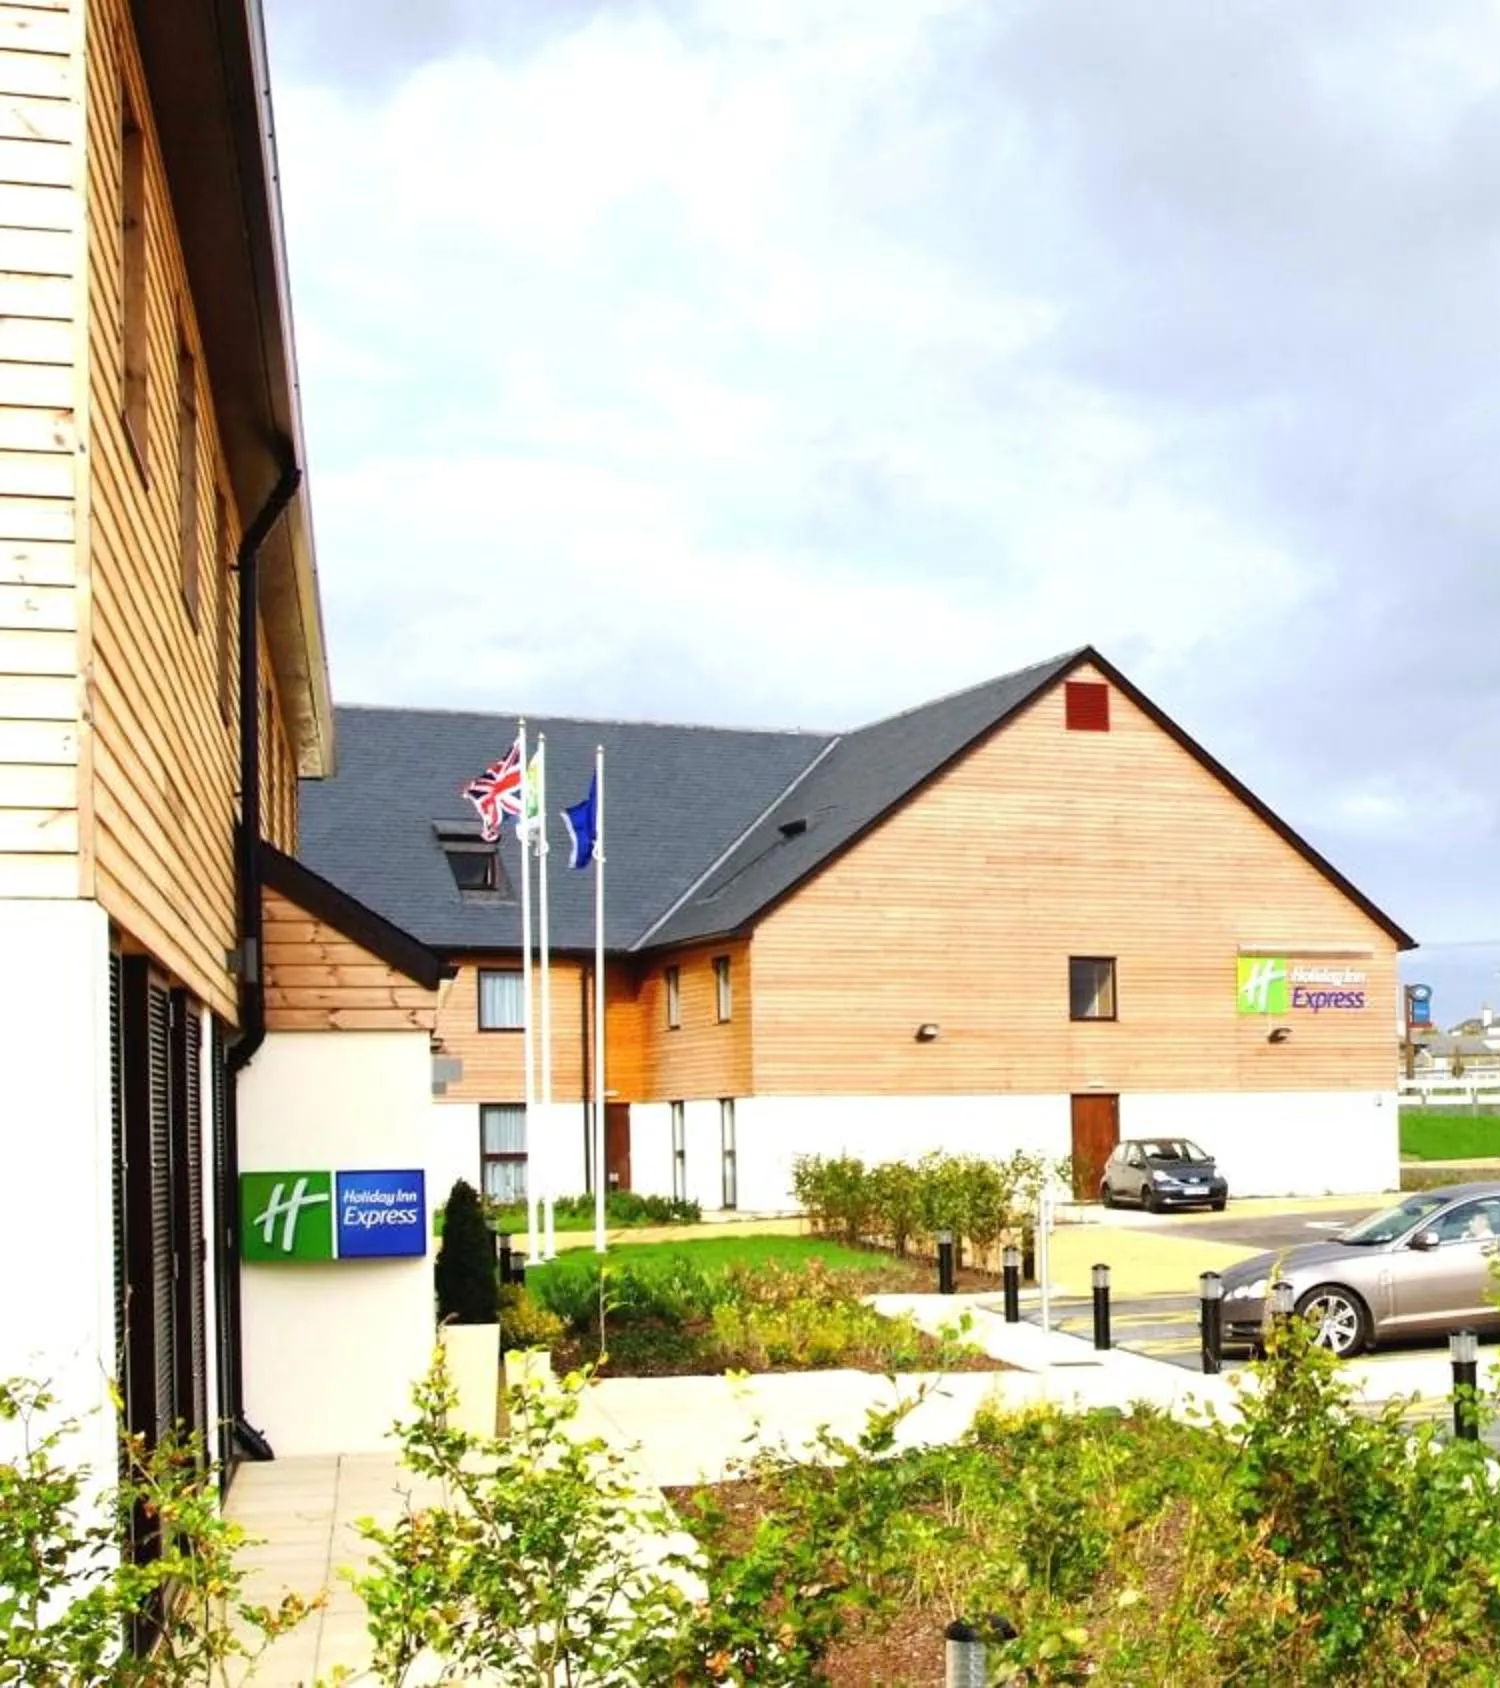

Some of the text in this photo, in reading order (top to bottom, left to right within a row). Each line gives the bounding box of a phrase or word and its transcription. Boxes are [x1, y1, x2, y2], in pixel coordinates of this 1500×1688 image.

[1292, 987, 1365, 1013] Express
[343, 1189, 417, 1206] Holiday Inn
[343, 1207, 417, 1228] Express
